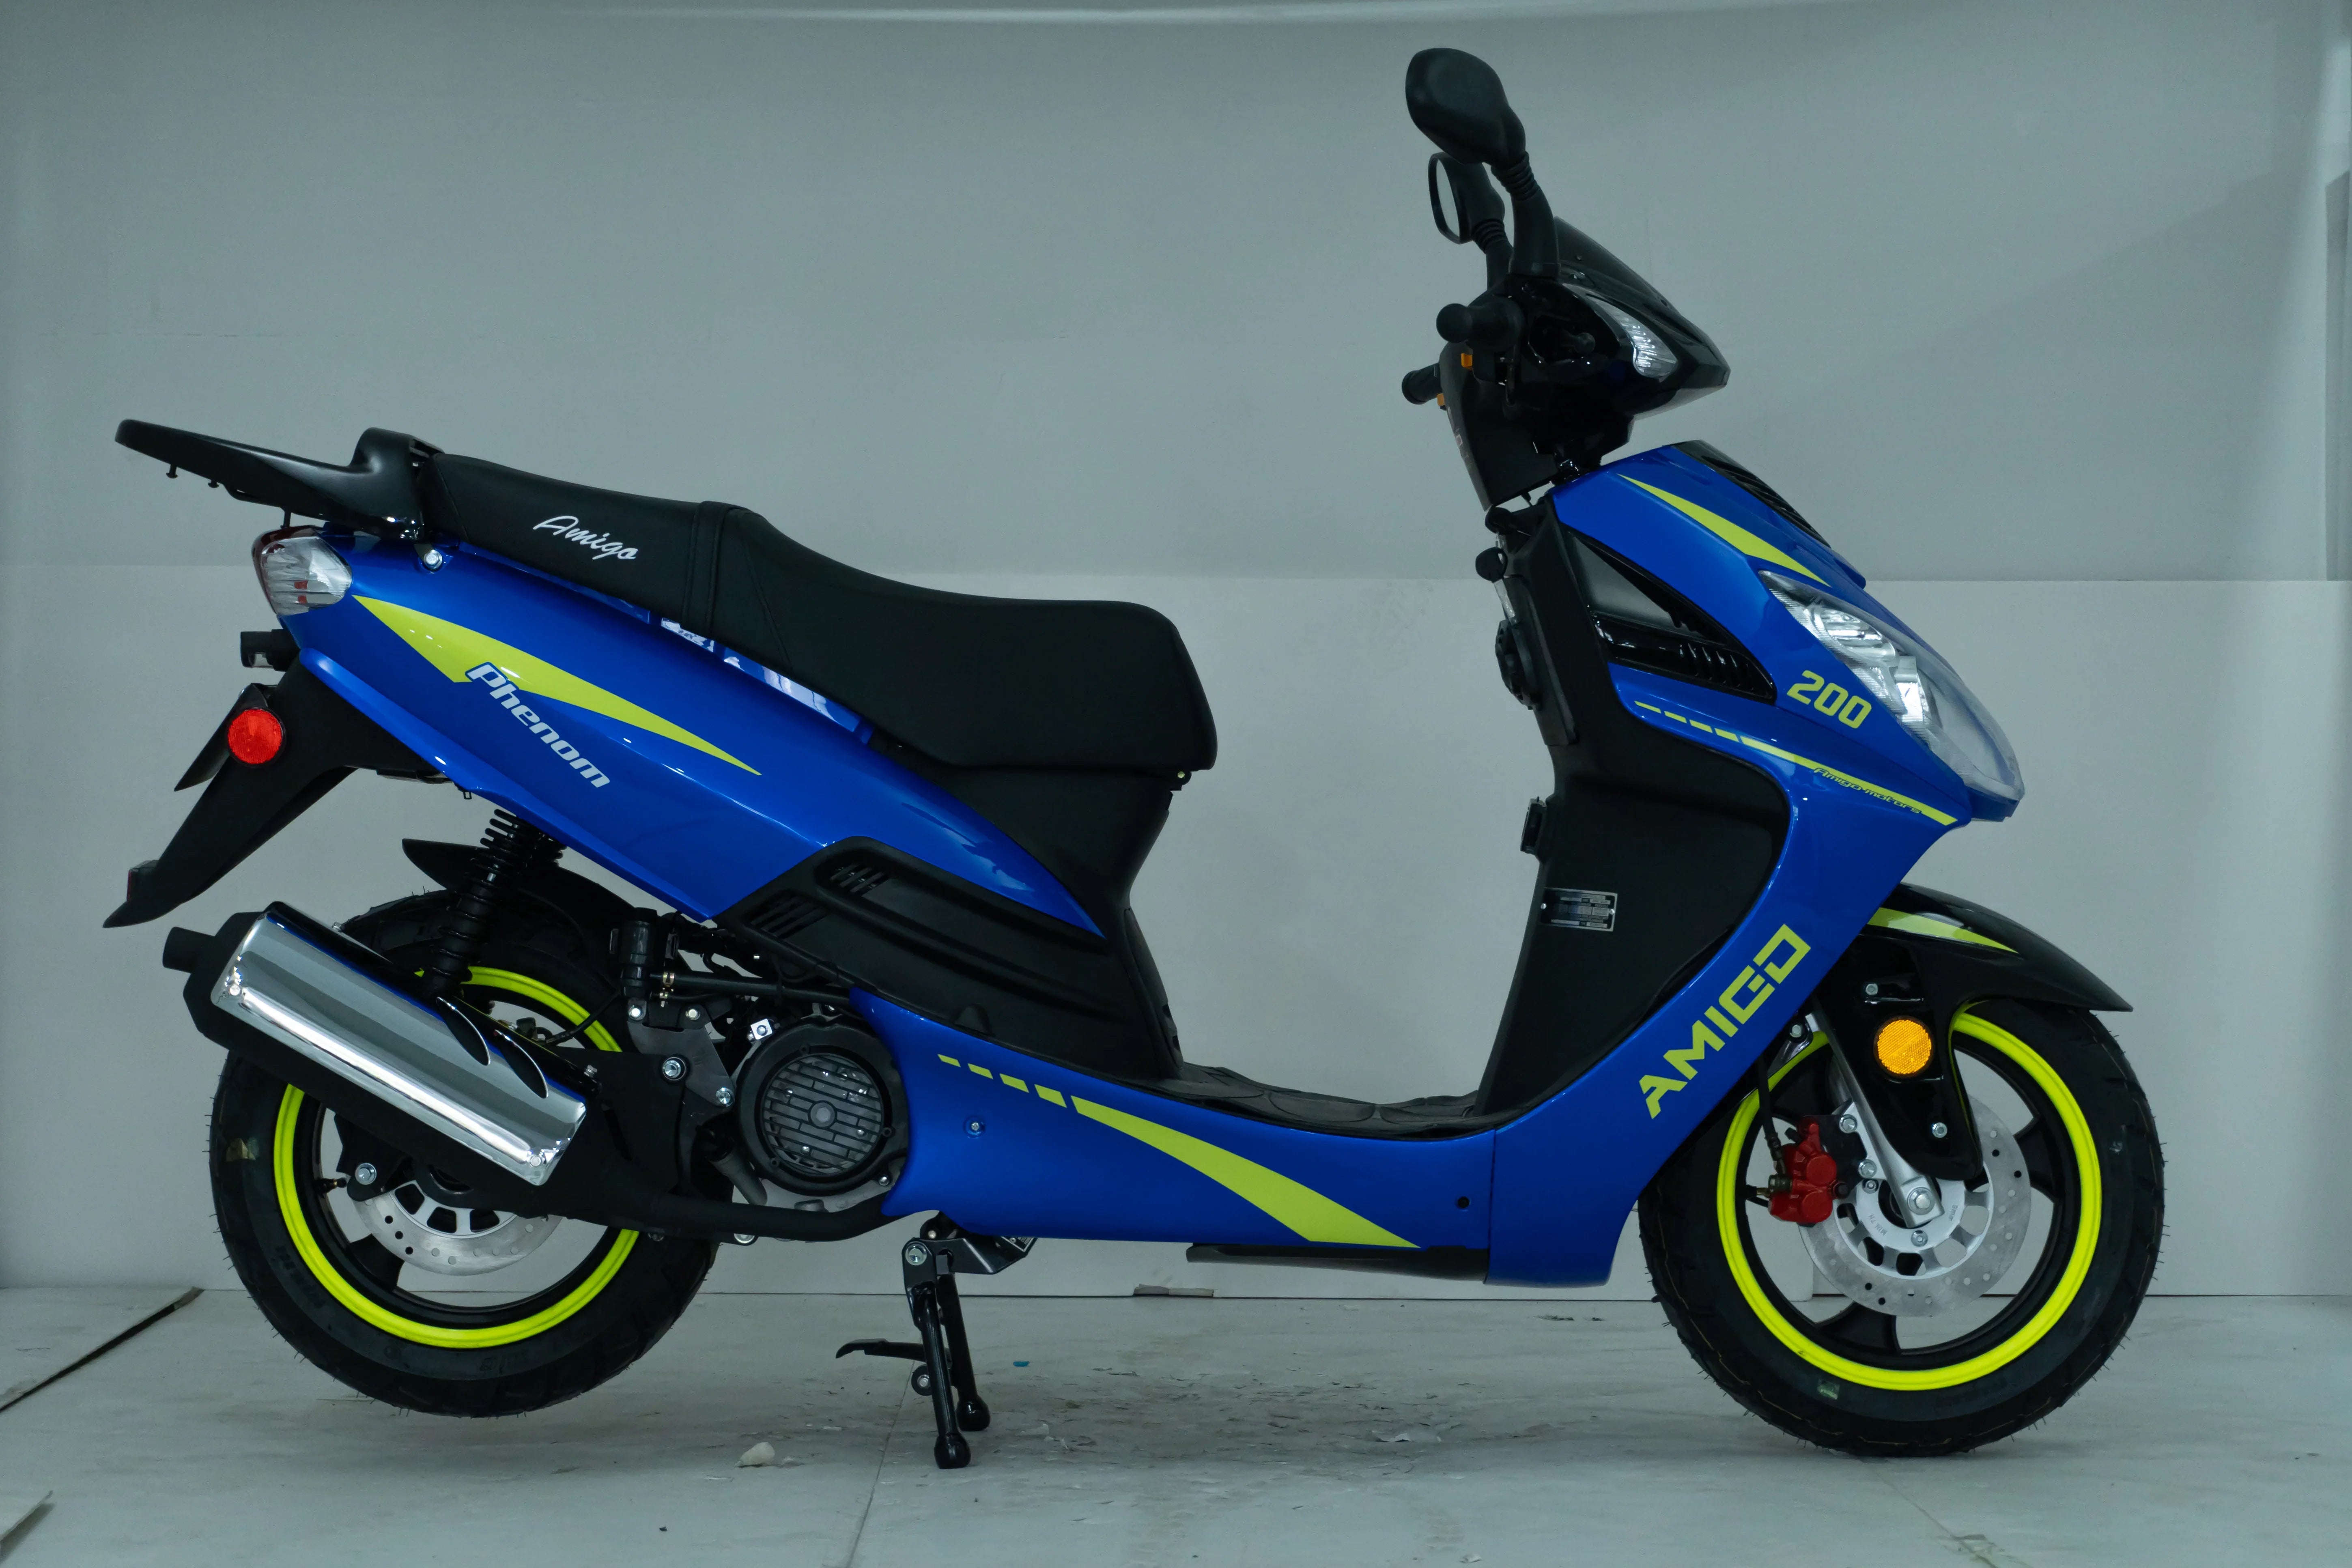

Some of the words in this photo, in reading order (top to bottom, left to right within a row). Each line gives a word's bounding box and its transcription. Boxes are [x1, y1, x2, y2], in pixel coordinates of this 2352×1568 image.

[533, 516, 639, 560] Amigo
[467, 664, 610, 788] Phenom
[1786, 670, 1872, 729] 200
[1814, 767, 1862, 791] Amigo
[1864, 789, 1922, 814] motors
[1639, 923, 1811, 1119] AMIGO
